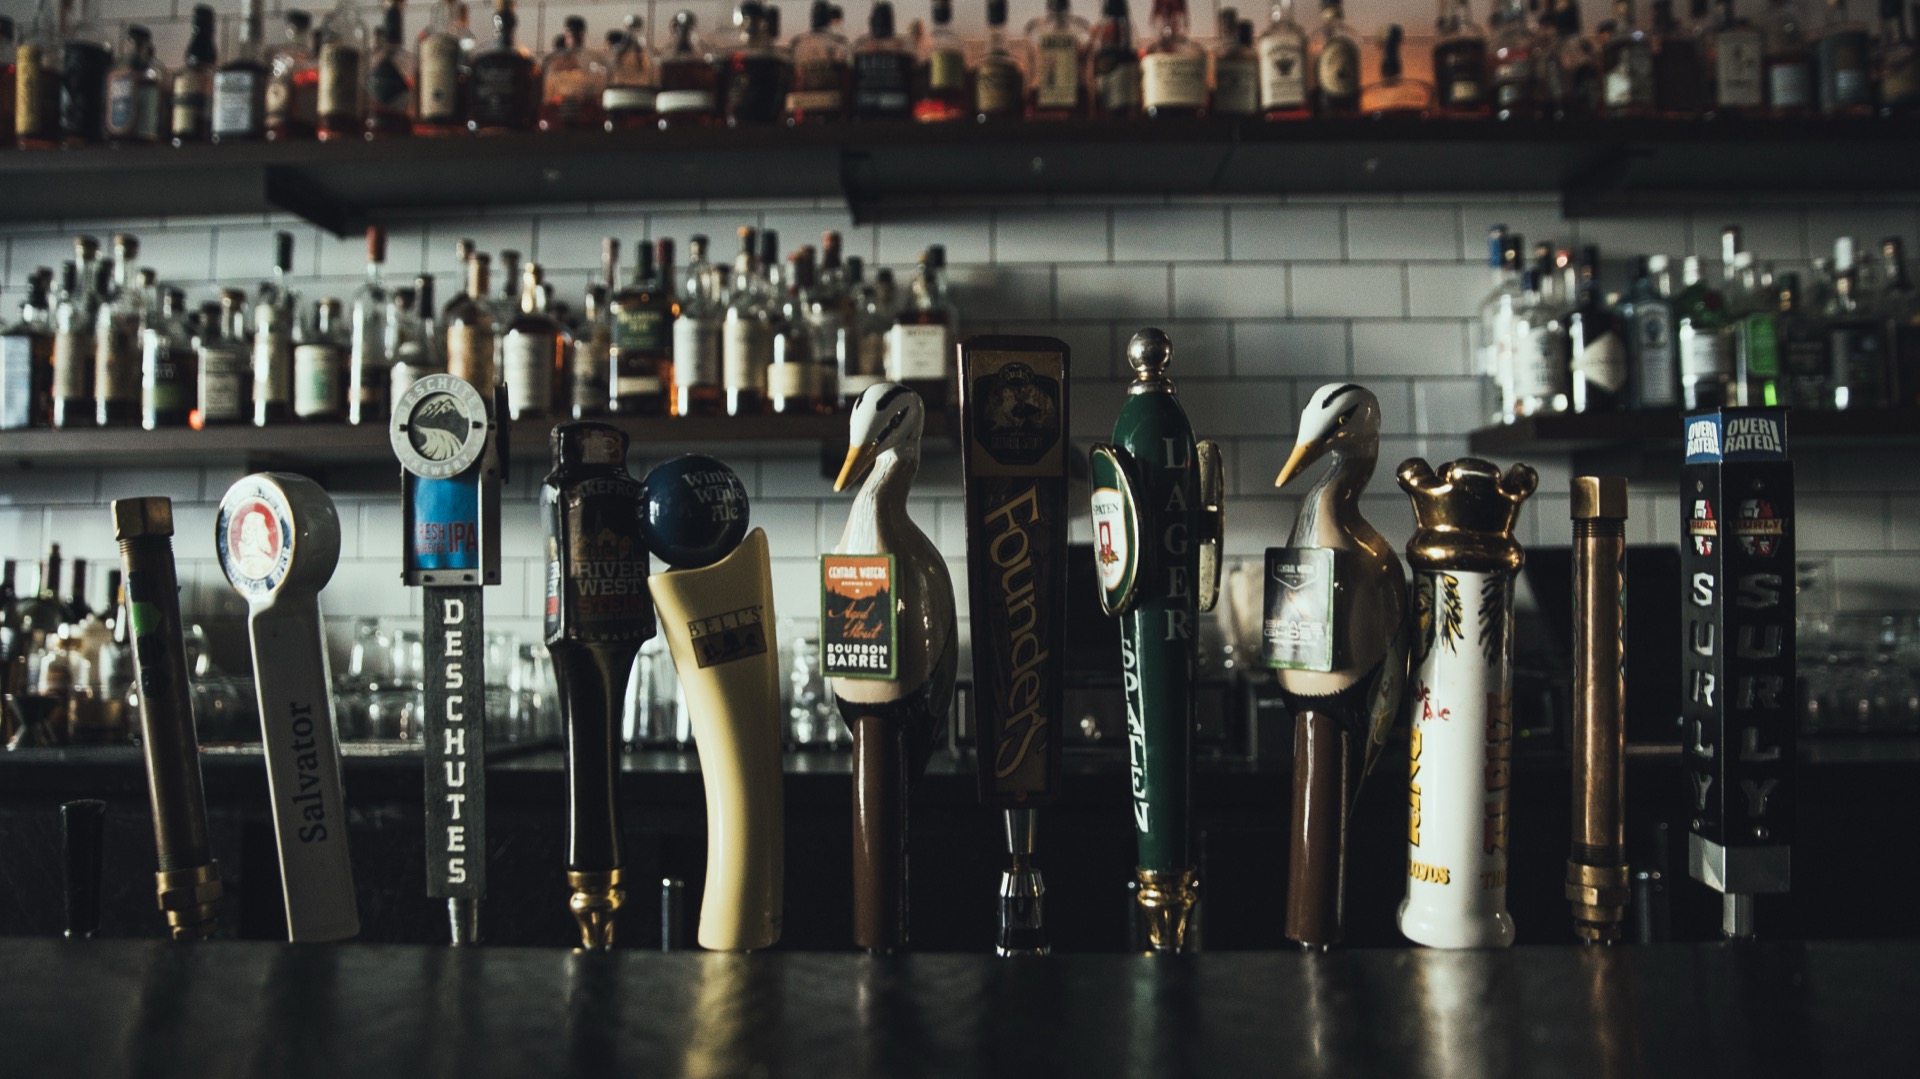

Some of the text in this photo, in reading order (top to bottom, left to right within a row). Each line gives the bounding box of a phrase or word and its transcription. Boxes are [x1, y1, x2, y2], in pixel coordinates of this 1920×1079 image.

[401, 376, 484, 418] DESCHUTES
[1687, 420, 1714, 440] OVER
[1726, 417, 1771, 437] OVER
[1686, 430, 1720, 457] RATED!
[1723, 427, 1783, 454] RATED!
[403, 452, 472, 476] BREWERY
[682, 469, 738, 488] Winter
[711, 504, 739, 522] Ale
[1093, 502, 1119, 516] SPATEN
[1691, 520, 1717, 529] SURLY
[447, 521, 478, 553] IPA
[1161, 436, 1189, 641] LAGER
[575, 560, 647, 578] RIVER
[576, 578, 641, 596] WEST
[984, 484, 1050, 779] Founders
[827, 643, 888, 655] BOURBON
[827, 653, 888, 669] BARREL
[1414, 679, 1431, 702] ale
[1689, 571, 1715, 811] SURLY
[1736, 572, 1783, 817] SURLY
[1422, 699, 1451, 721] Ale
[443, 598, 467, 884] DESCHUTES
[1122, 637, 1150, 833] SPATEN
[290, 701, 328, 843] Salvator
